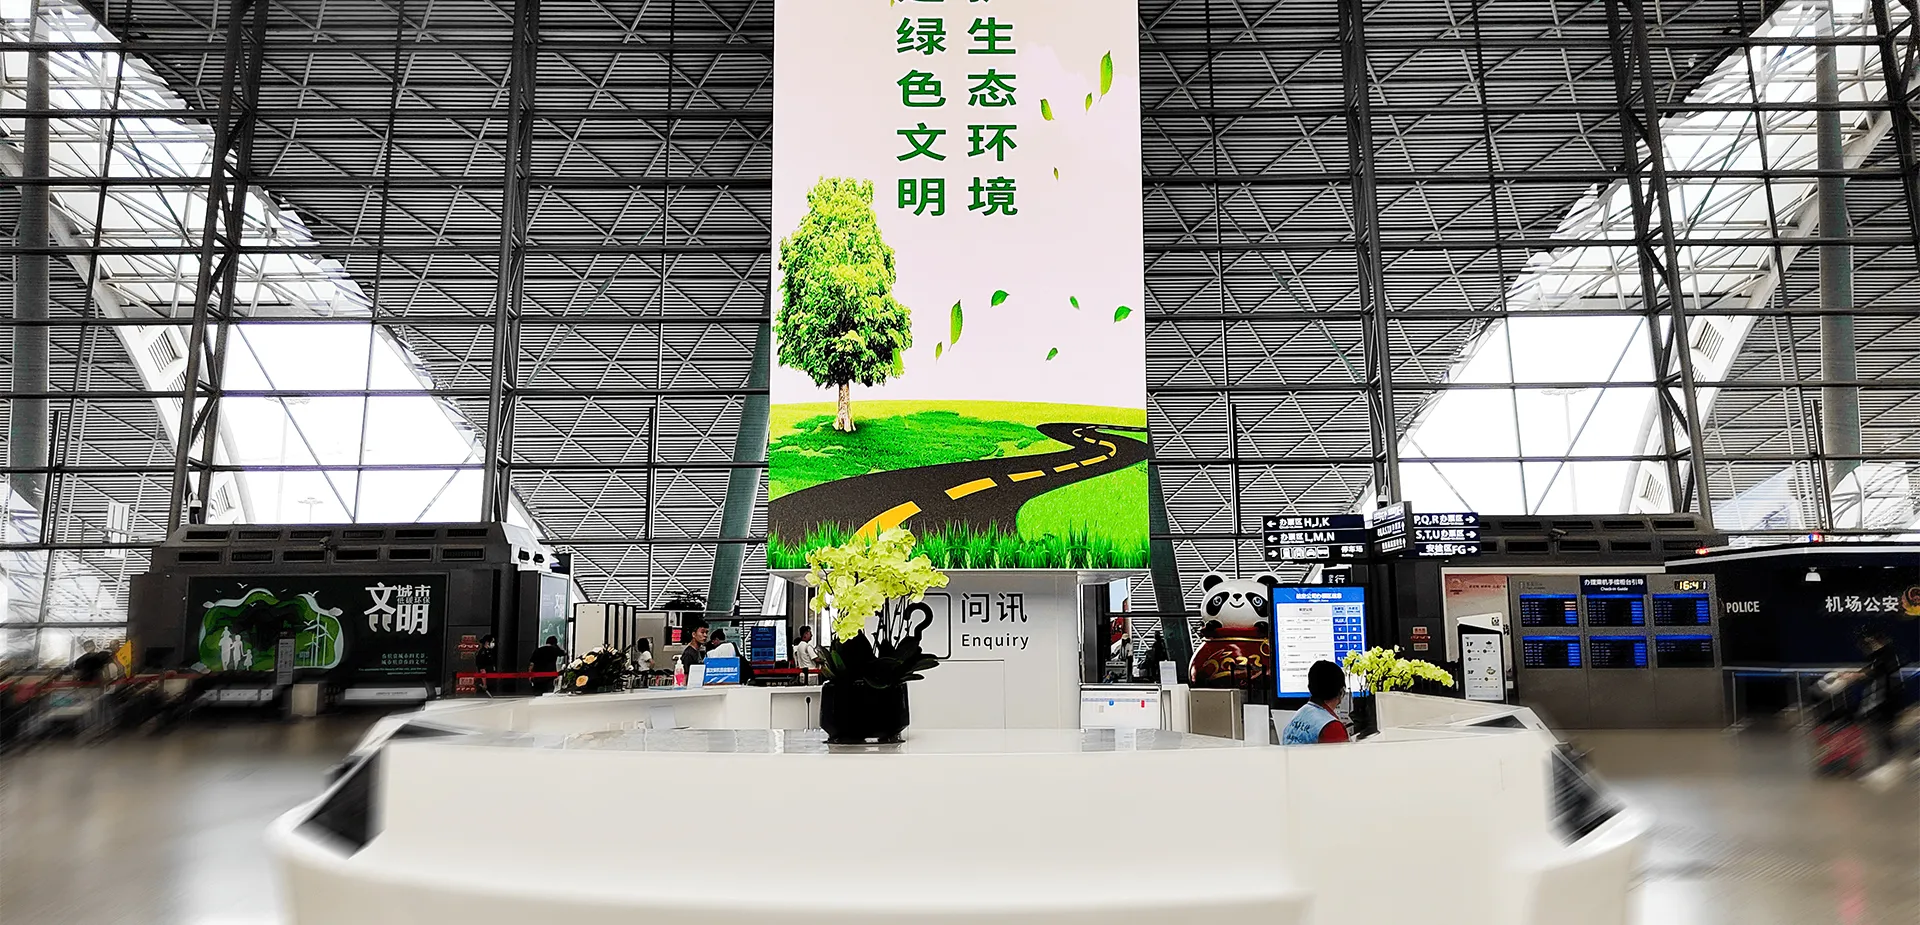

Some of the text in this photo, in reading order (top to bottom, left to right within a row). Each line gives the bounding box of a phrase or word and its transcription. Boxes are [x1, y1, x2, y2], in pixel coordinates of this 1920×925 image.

[896, 0, 947, 217] 绿色文明
[967, 0, 1018, 216] 生态环境
[1679, 580, 1707, 590] 16:41
[961, 592, 1028, 624] 问讯
[1726, 601, 1760, 613] POLICE
[1825, 596, 1899, 613] 机场公安
[961, 632, 1029, 650] Enquiry
